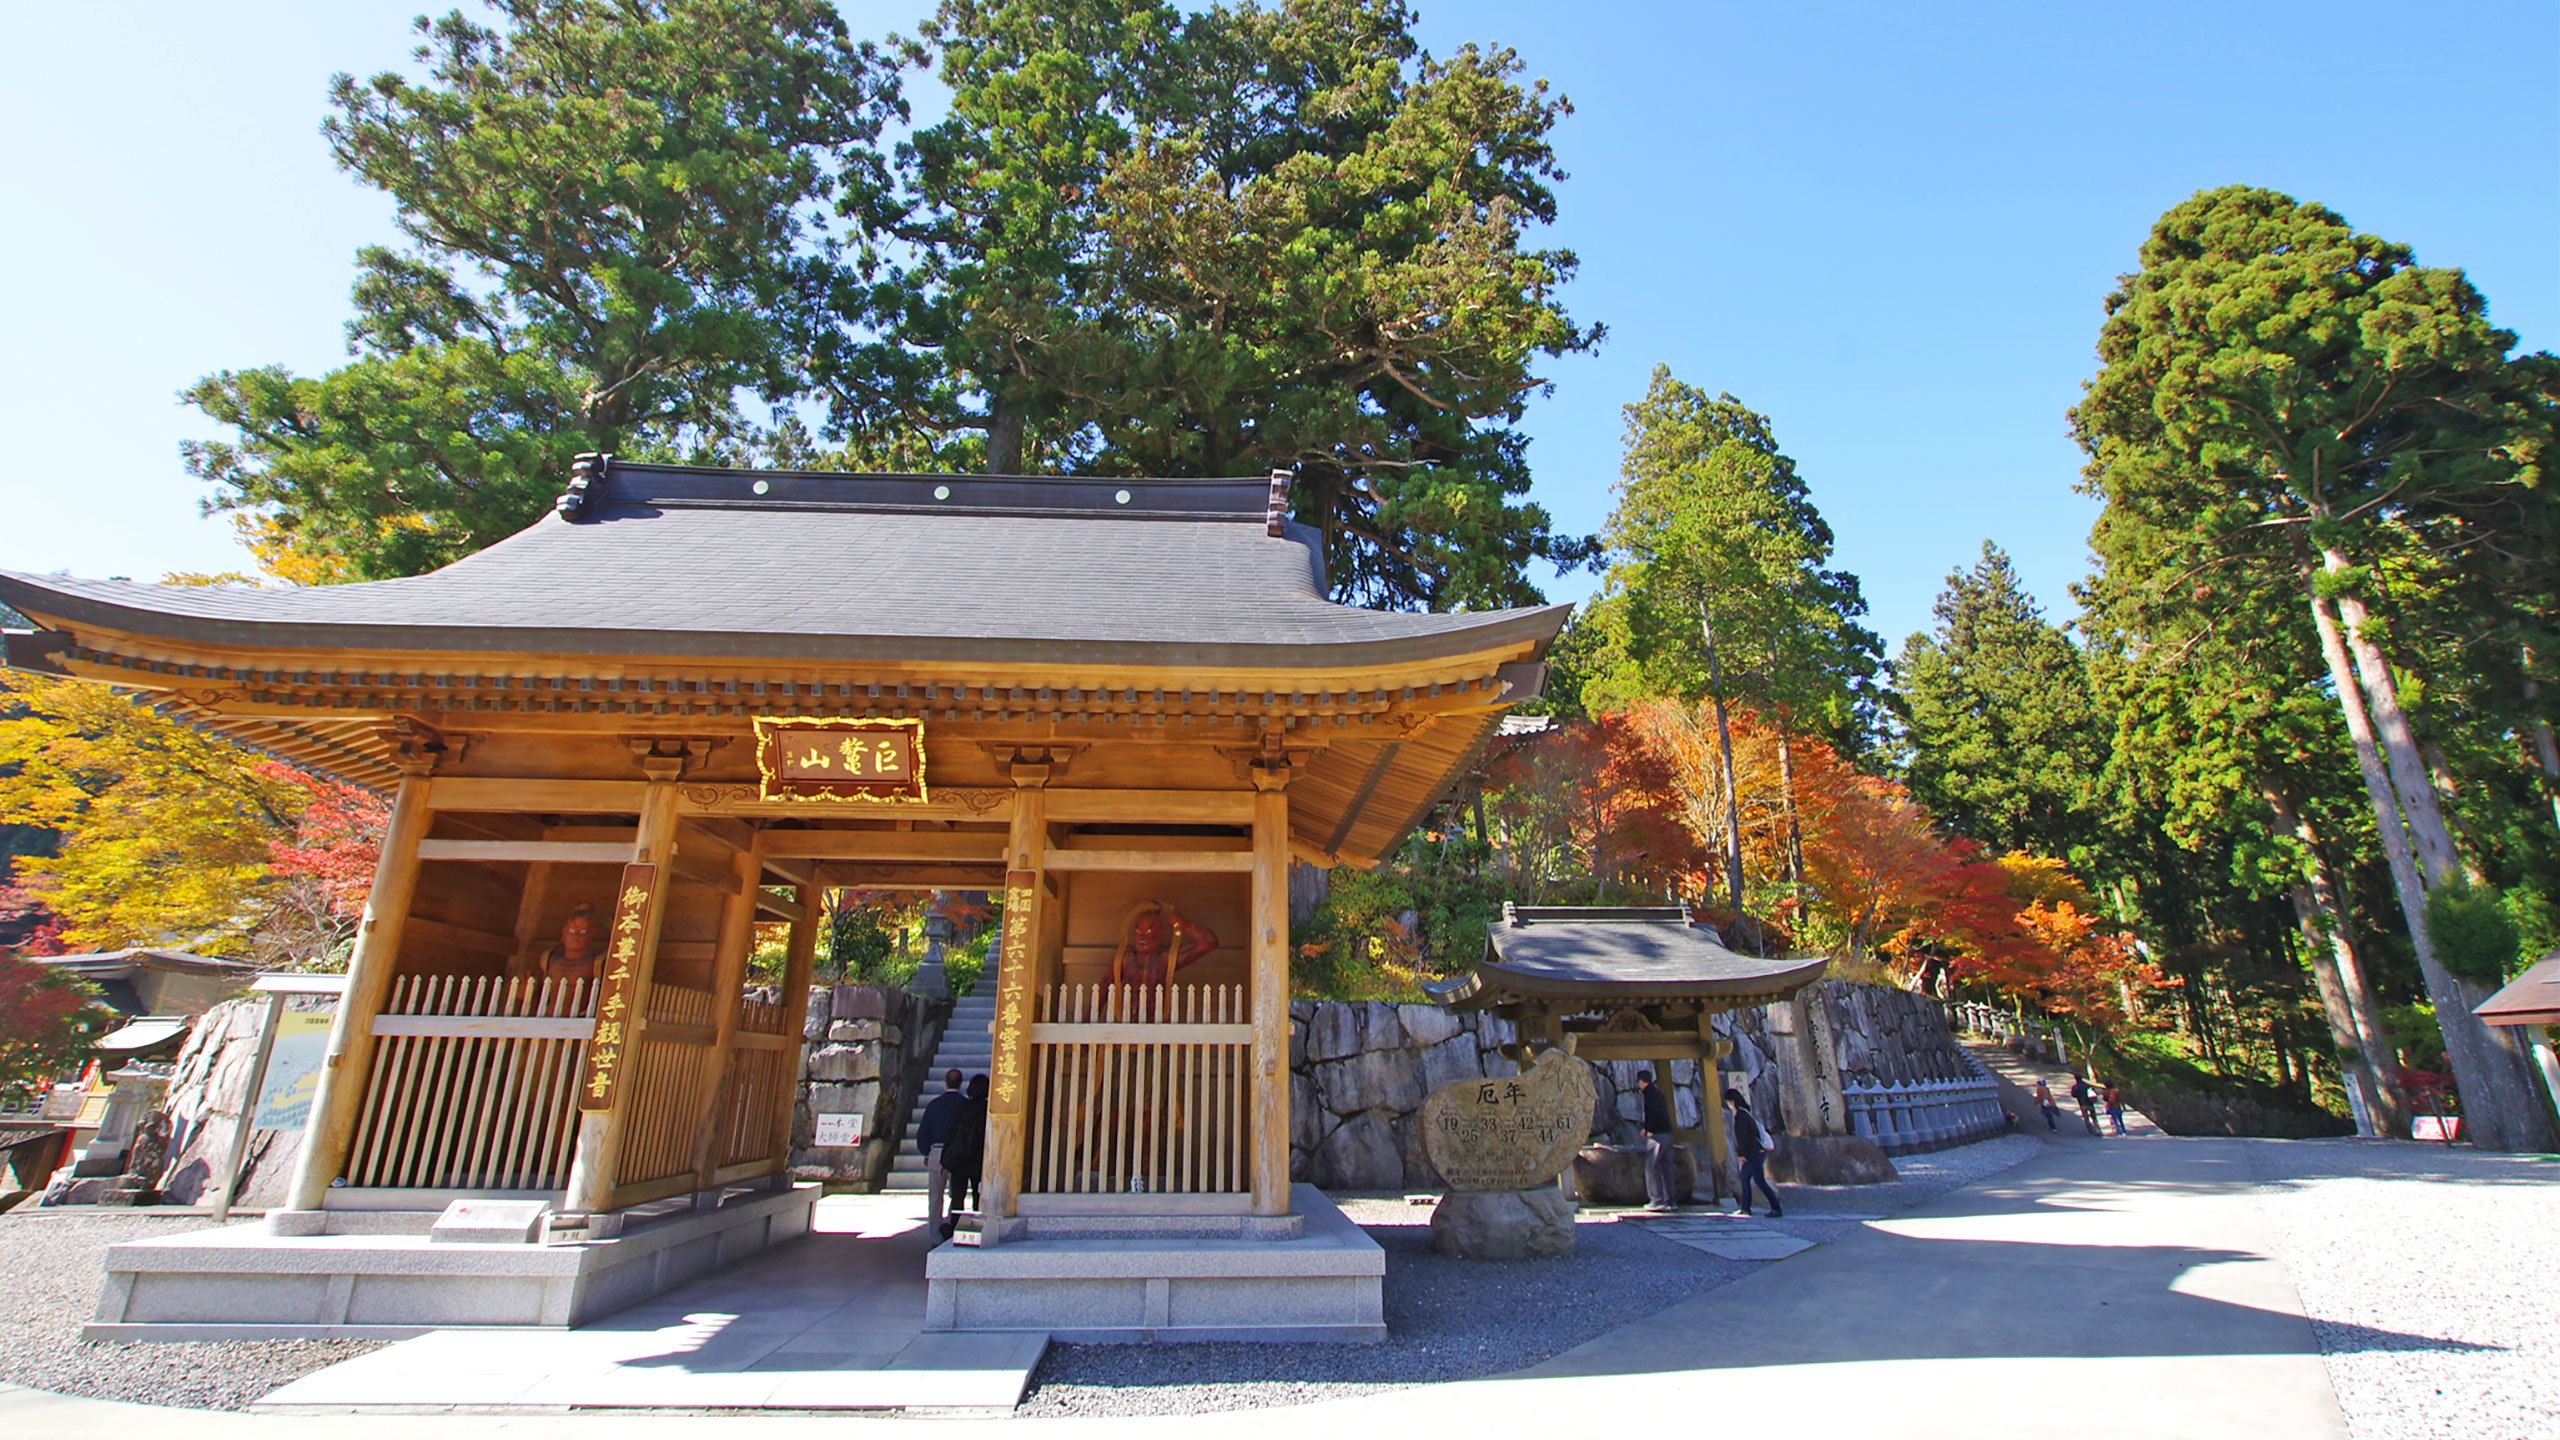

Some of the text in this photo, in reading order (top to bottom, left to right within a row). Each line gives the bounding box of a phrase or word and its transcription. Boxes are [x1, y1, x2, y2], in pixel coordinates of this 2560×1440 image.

[1476, 1082, 1526, 1106] 厄年
[1443, 1117, 1571, 1130] 19 33 42 61
[1462, 1130, 1554, 1143] 25 37 44
